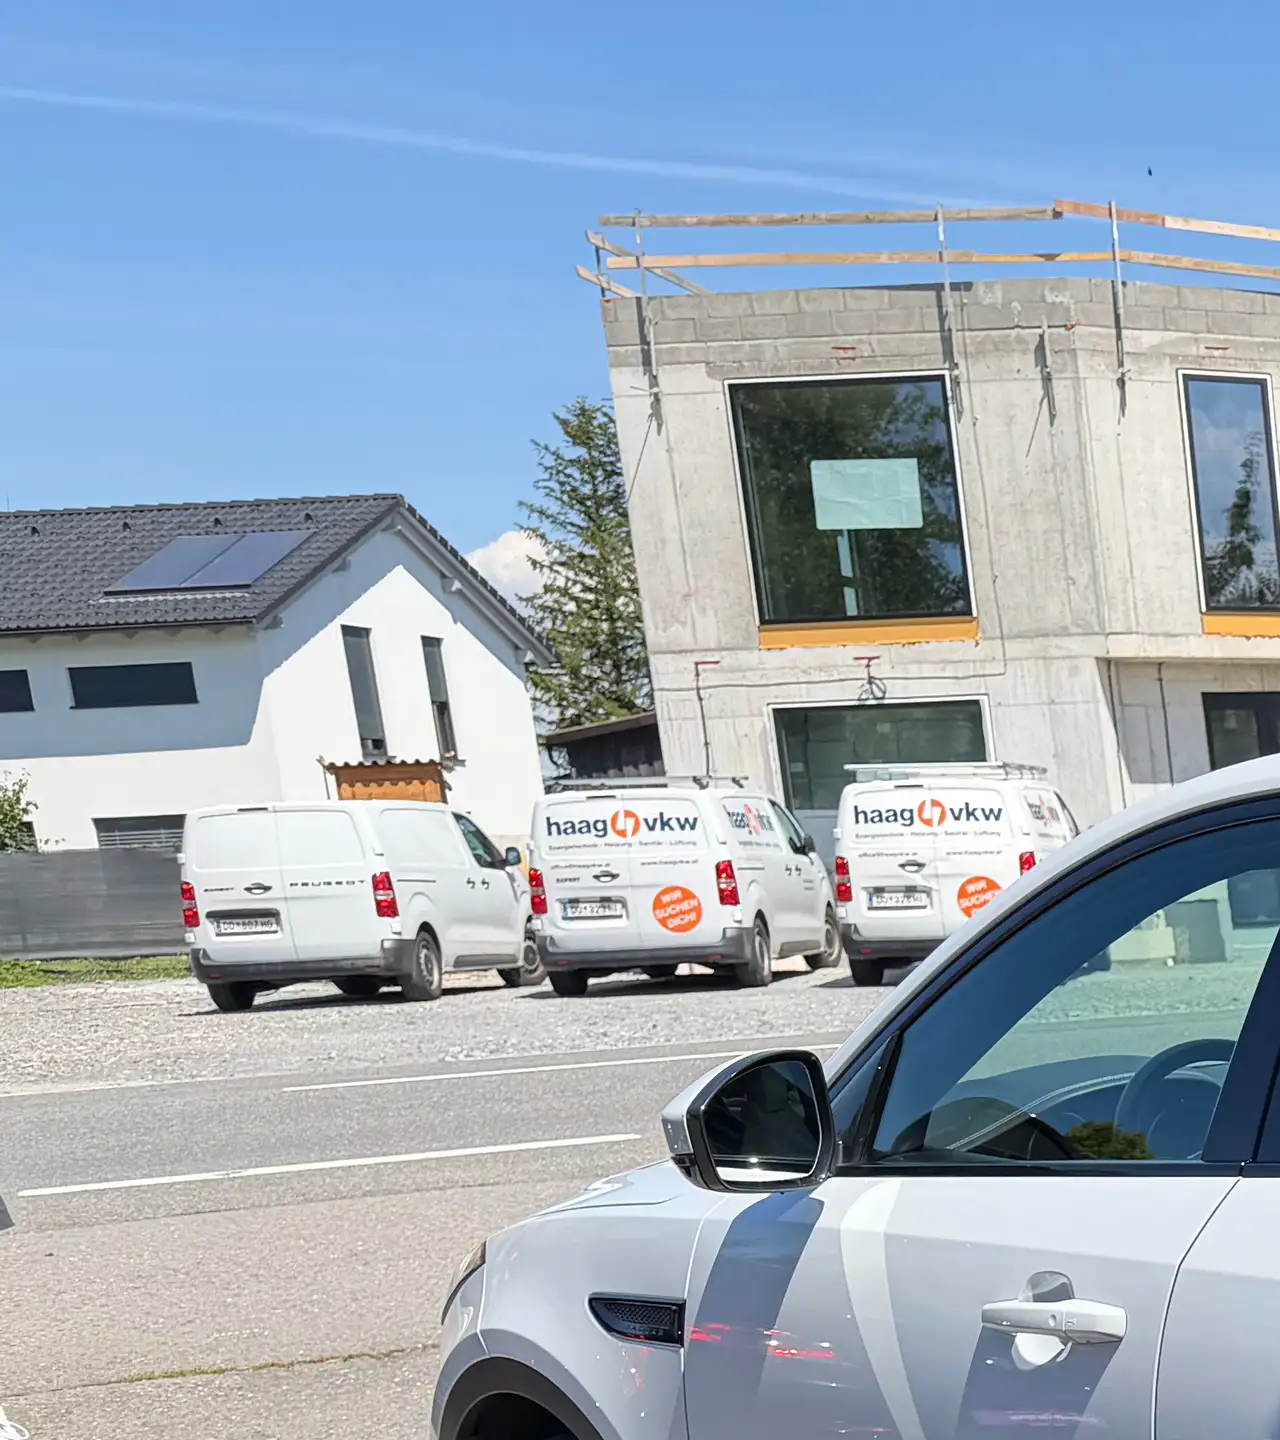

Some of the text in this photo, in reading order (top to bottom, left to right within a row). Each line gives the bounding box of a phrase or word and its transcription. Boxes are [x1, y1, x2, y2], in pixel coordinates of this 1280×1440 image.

[546, 811, 698, 838] haag vkw
[854, 805, 915, 827] haag
[949, 802, 1003, 822] vkw
[660, 889, 683, 904] WIR
[654, 898, 699, 921] SUCHEN
